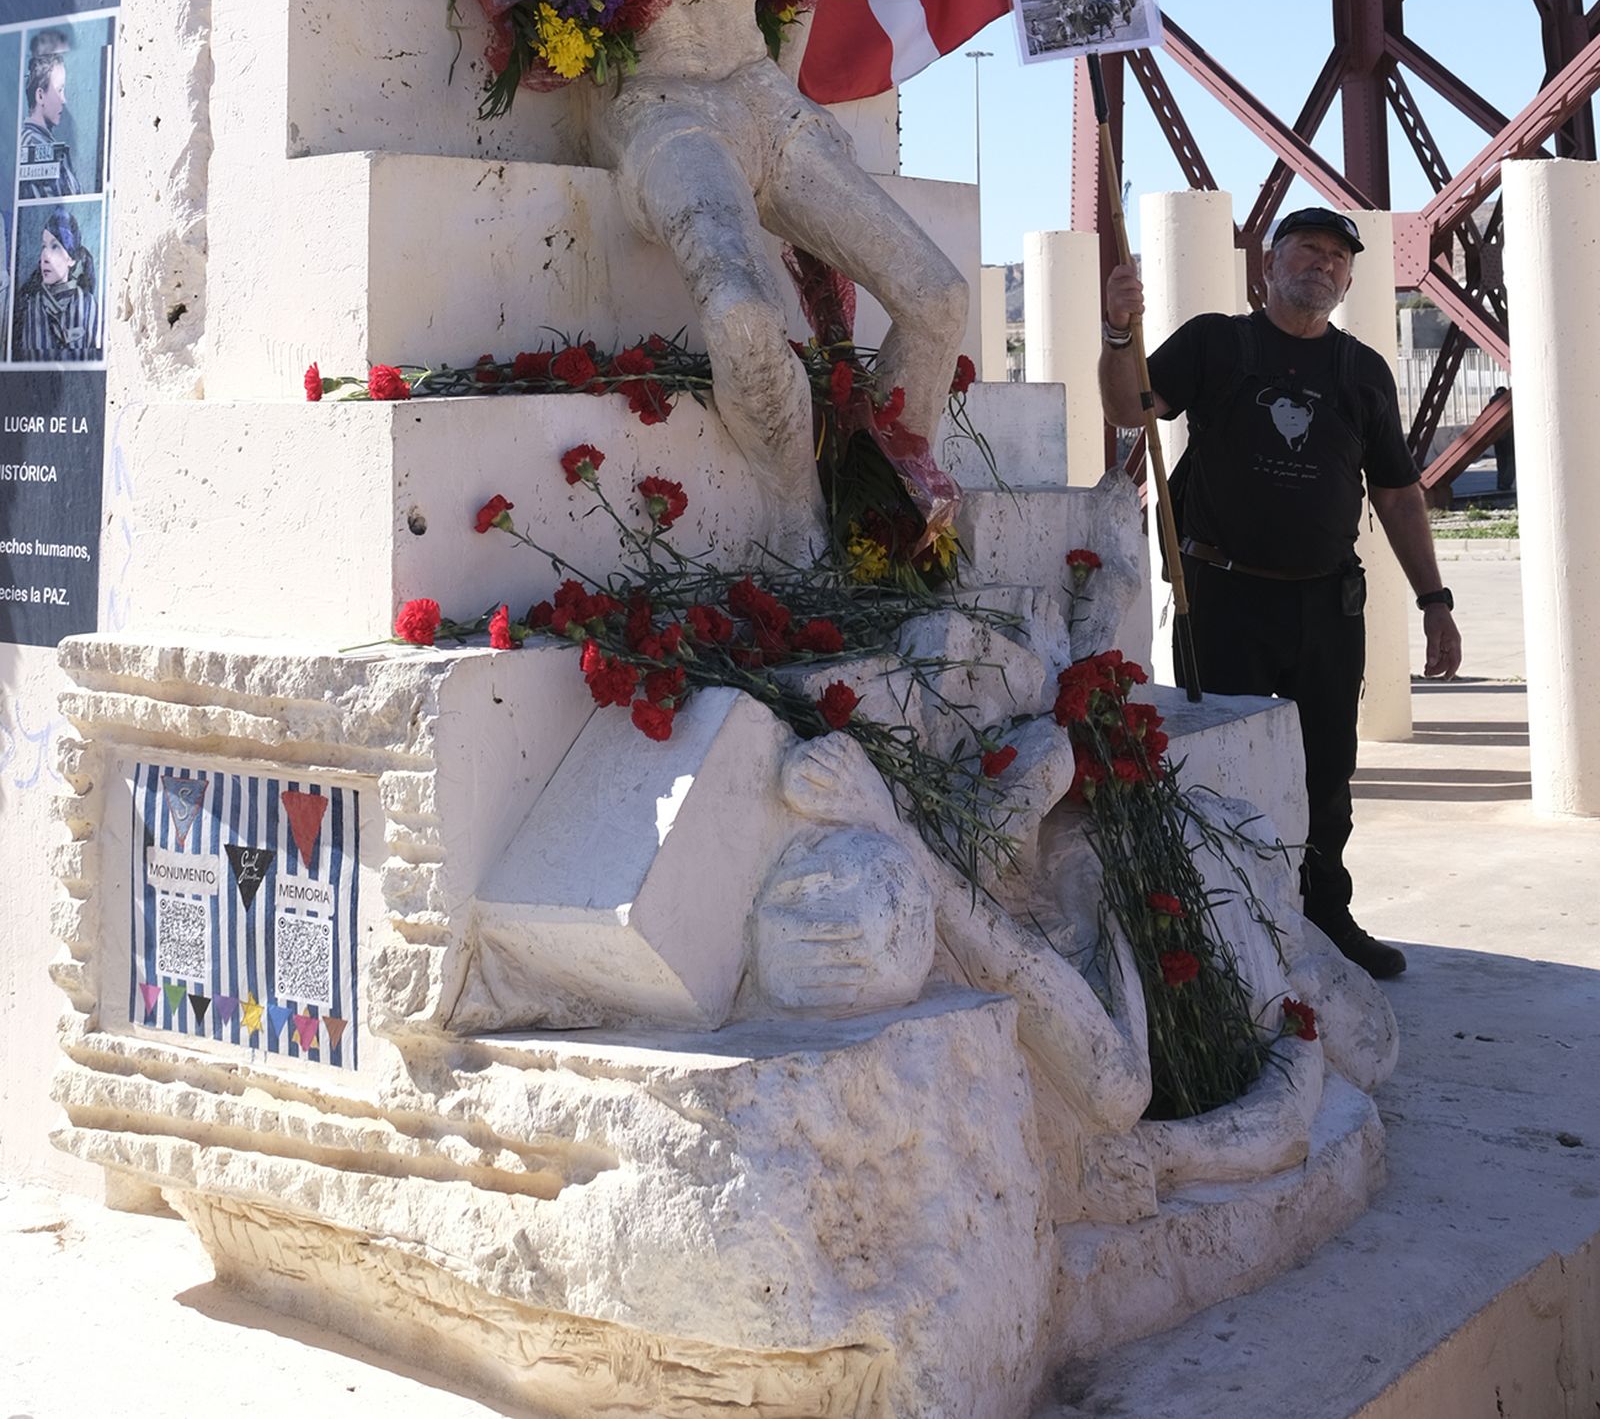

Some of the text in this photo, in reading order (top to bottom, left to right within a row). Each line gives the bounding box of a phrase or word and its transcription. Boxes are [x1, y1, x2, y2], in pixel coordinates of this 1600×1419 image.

[4, 416, 89, 434] LUGAR DE LA
[0, 461, 58, 483] ISTÓRICA
[0, 538, 91, 562] echos humanos,
[0, 585, 70, 606] ecies la PAZ.
[149, 863, 216, 885] MONUMENTO
[279, 883, 331, 904] MEMORIA
